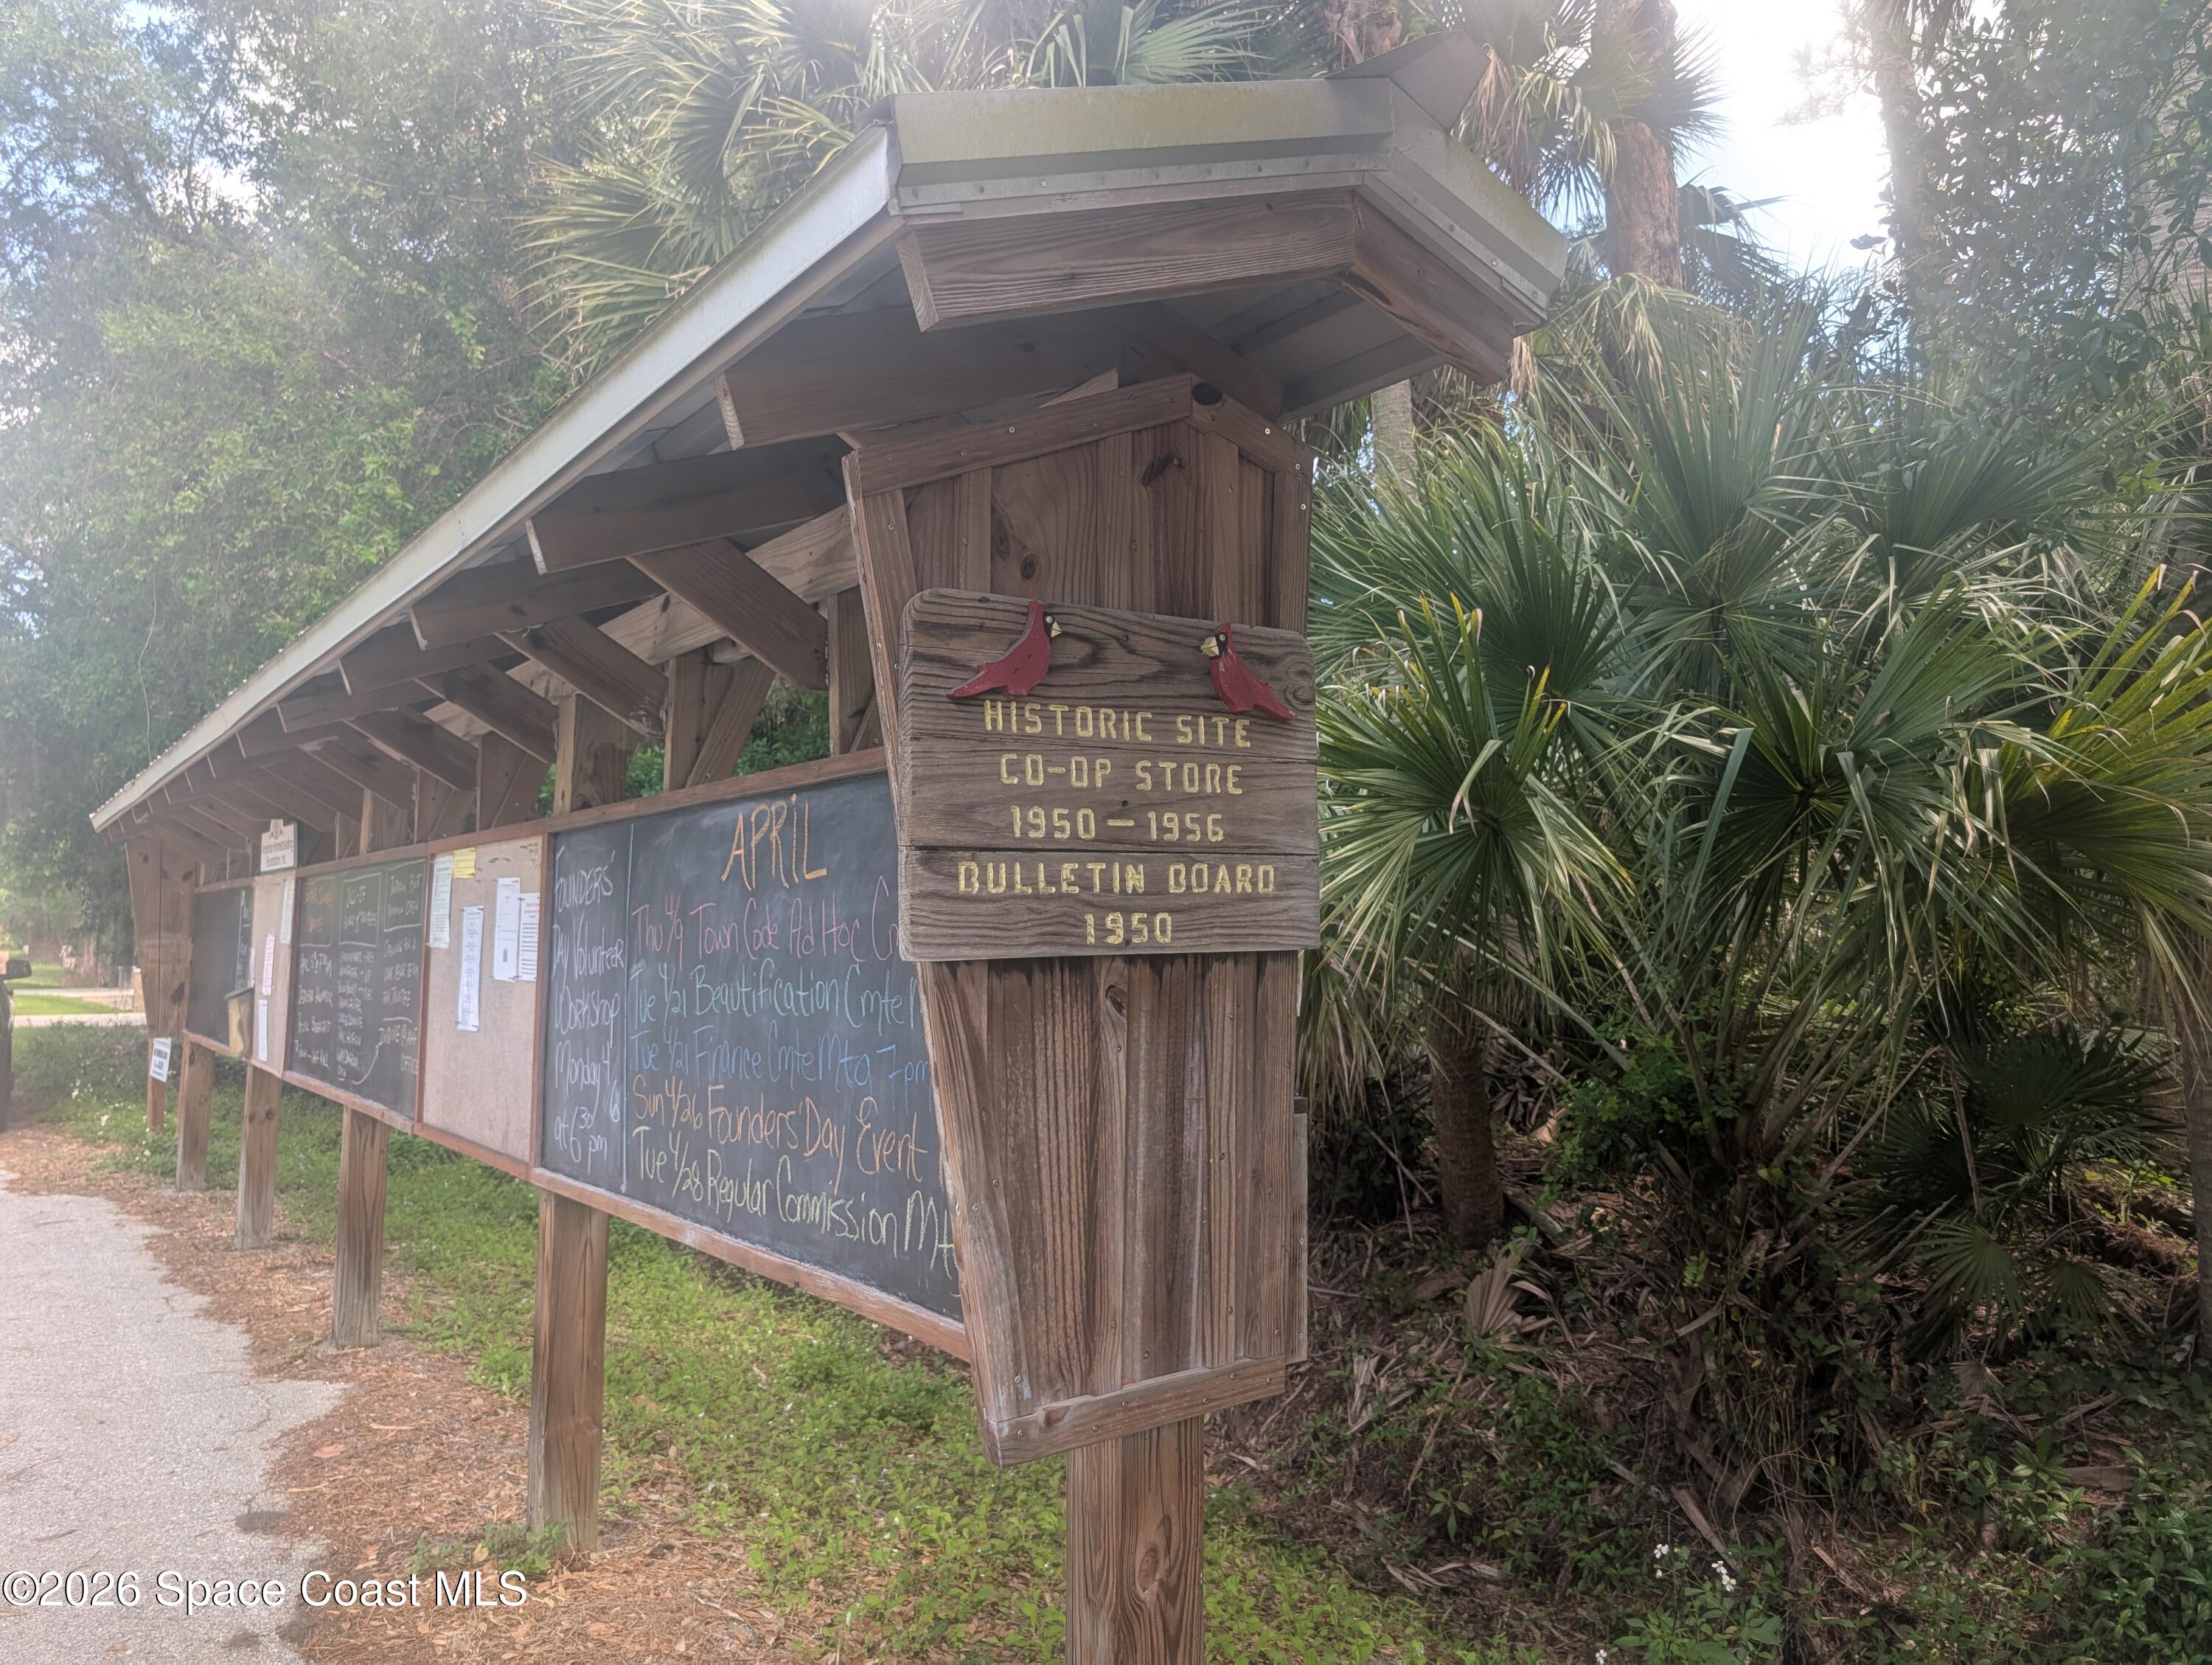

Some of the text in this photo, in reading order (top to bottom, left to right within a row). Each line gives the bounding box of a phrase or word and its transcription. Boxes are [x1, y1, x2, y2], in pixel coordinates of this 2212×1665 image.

[984, 700, 1251, 748] HISTORIC SITE
[1000, 753, 1242, 795] CO-OP STORE
[959, 861, 1275, 895] BULLETIN BOARD
[631, 904, 664, 955] Thu
[665, 894, 683, 973] 4/9
[690, 903, 739, 959] Town
[744, 897, 780, 960] Code
[790, 897, 815, 959] Ad
[1085, 911, 1172, 945] 1950
[630, 967, 656, 1030] Tue
[659, 962, 687, 1027] 4/21
[690, 958, 839, 1018] Beautification
[844, 962, 904, 1037] Cmte
[556, 1040, 601, 1125] Monday
[630, 1029, 659, 1071] Tue
[664, 1026, 689, 1075] 4/21
[692, 1025, 763, 1087] Finance
[768, 1020, 816, 1091] Cmte
[818, 1032, 872, 1122] Mtg
[554, 1109, 570, 1150] at
[633, 1073, 664, 1126] Sun
[665, 1075, 703, 1132] 4/26
[803, 1096, 846, 1197] Day
[855, 1096, 929, 1183] Event
[632, 1125, 667, 1183] Tue
[668, 1130, 703, 1203] 4/28
[708, 1147, 775, 1223] Regular
[777, 1154, 898, 1259] Commission
[903, 1189, 959, 1281] Mt
